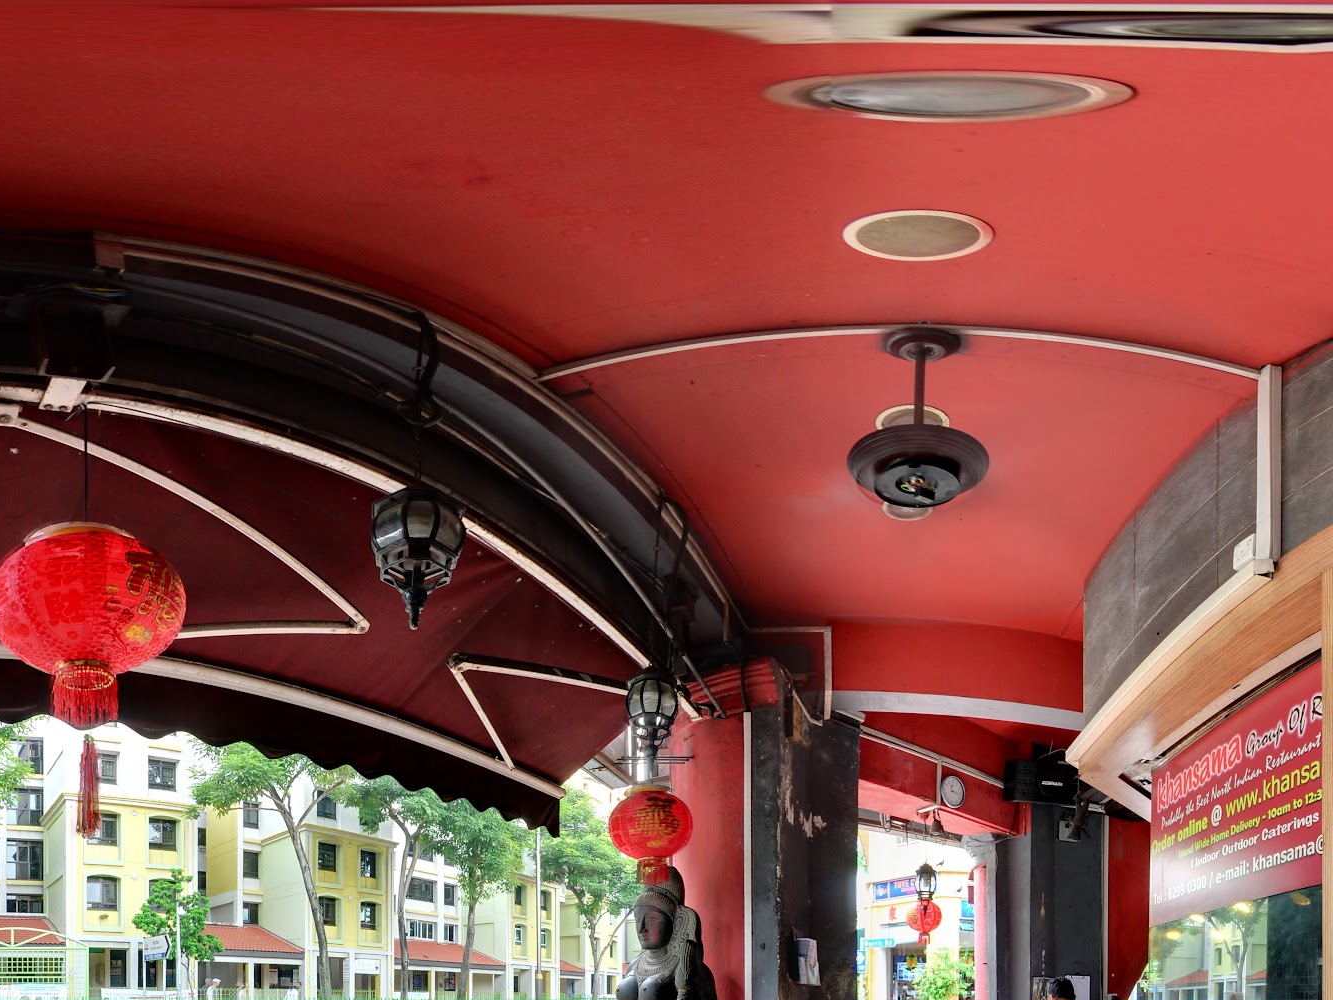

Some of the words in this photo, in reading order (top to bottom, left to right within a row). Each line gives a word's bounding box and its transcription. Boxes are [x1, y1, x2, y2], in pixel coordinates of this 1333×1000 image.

[1157, 735, 1242, 812] khansama
[1245, 724, 1284, 756] Group
[1288, 700, 1308, 734] Of
[1185, 801, 1195, 816] the
[1195, 792, 1210, 811] Best
[1211, 781, 1233, 803] North
[1233, 768, 1263, 790] Indian
[1151, 832, 1176, 856] Order
[1177, 815, 1209, 841] online
[1211, 804, 1223, 827] @
[1210, 828, 1230, 847] Home
[1230, 816, 1261, 838] Delivery
[1267, 803, 1291, 820] 10am
[1293, 798, 1304, 810] to
[1221, 833, 1260, 857] Outdoor
[1261, 811, 1320, 842] Caterings
[1186, 875, 1208, 894] 0300
[1215, 862, 1250, 885] e-mail:
